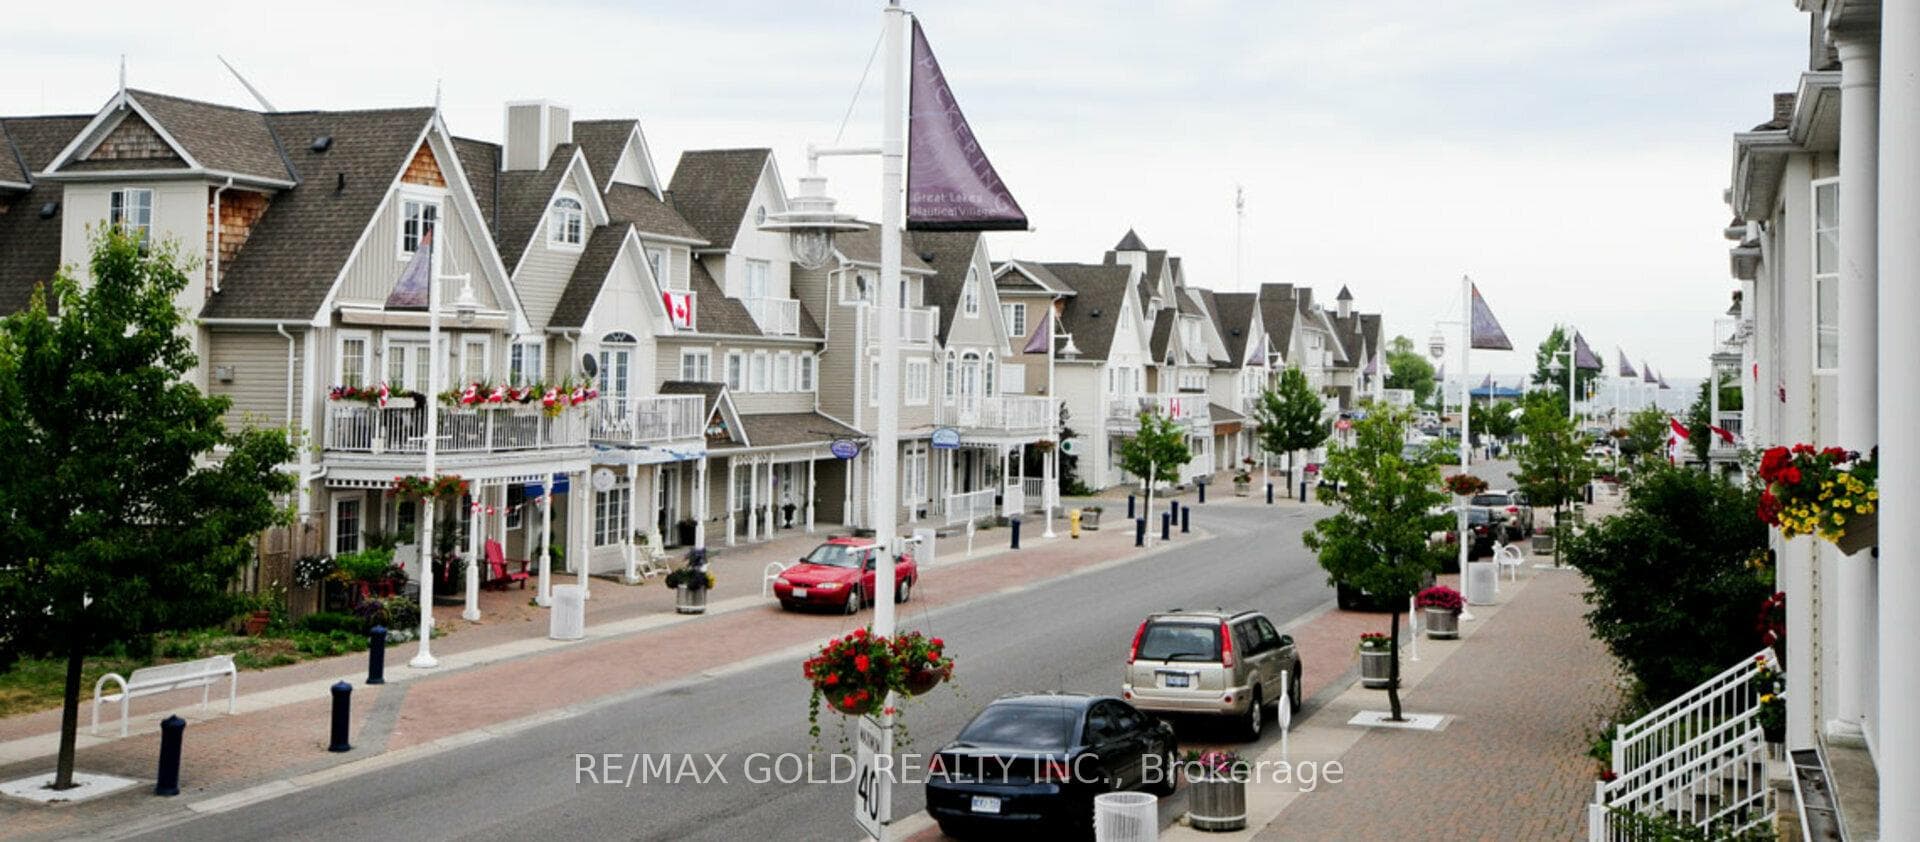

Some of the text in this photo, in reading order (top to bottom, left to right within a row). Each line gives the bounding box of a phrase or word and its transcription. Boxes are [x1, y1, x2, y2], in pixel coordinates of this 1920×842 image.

[918, 57, 1011, 212] PICKERING
[912, 192, 946, 203] Great
[912, 207, 958, 217] Nautical
[858, 764, 879, 821] 40
